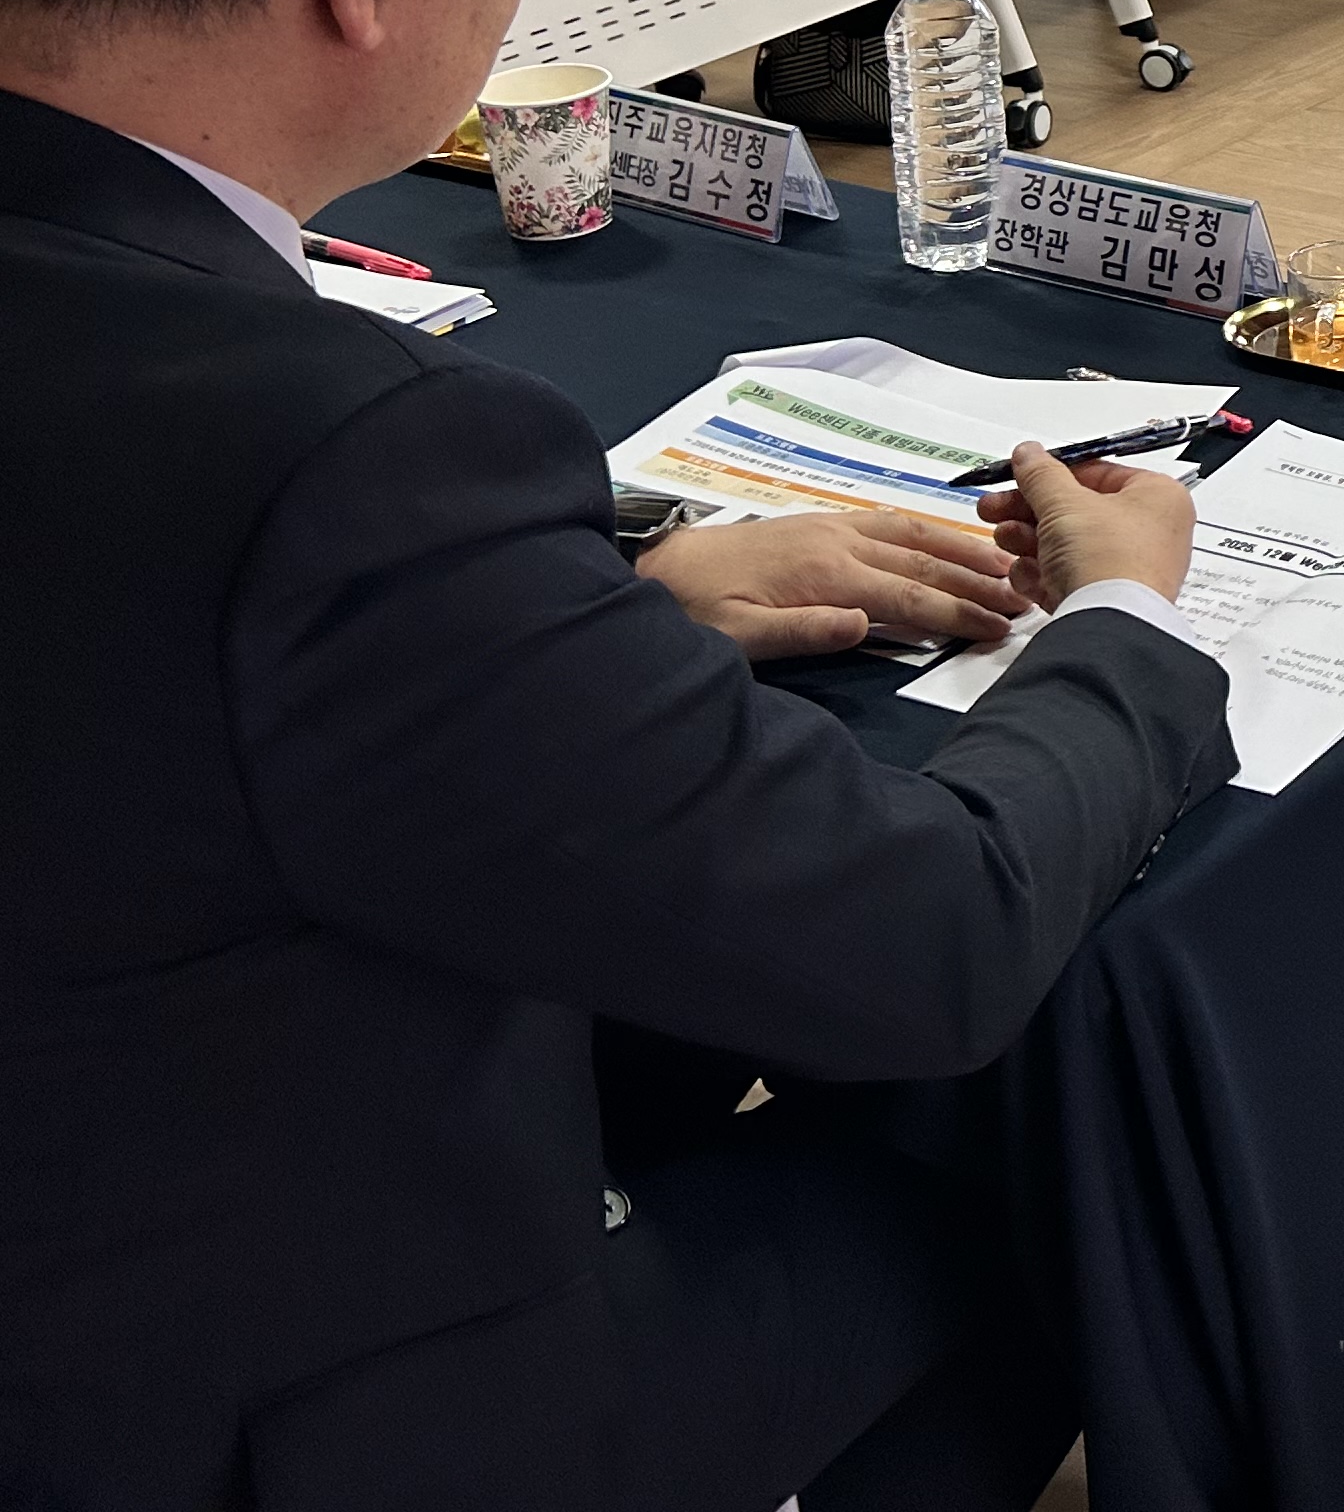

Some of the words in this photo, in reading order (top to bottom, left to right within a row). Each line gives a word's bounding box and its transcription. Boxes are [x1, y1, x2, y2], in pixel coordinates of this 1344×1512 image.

[611, 150, 660, 188] 센터장
[1020, 172, 1223, 248] 경상남도교육청
[994, 217, 1070, 264] 장학관
[787, 402, 852, 430] Wee센터
